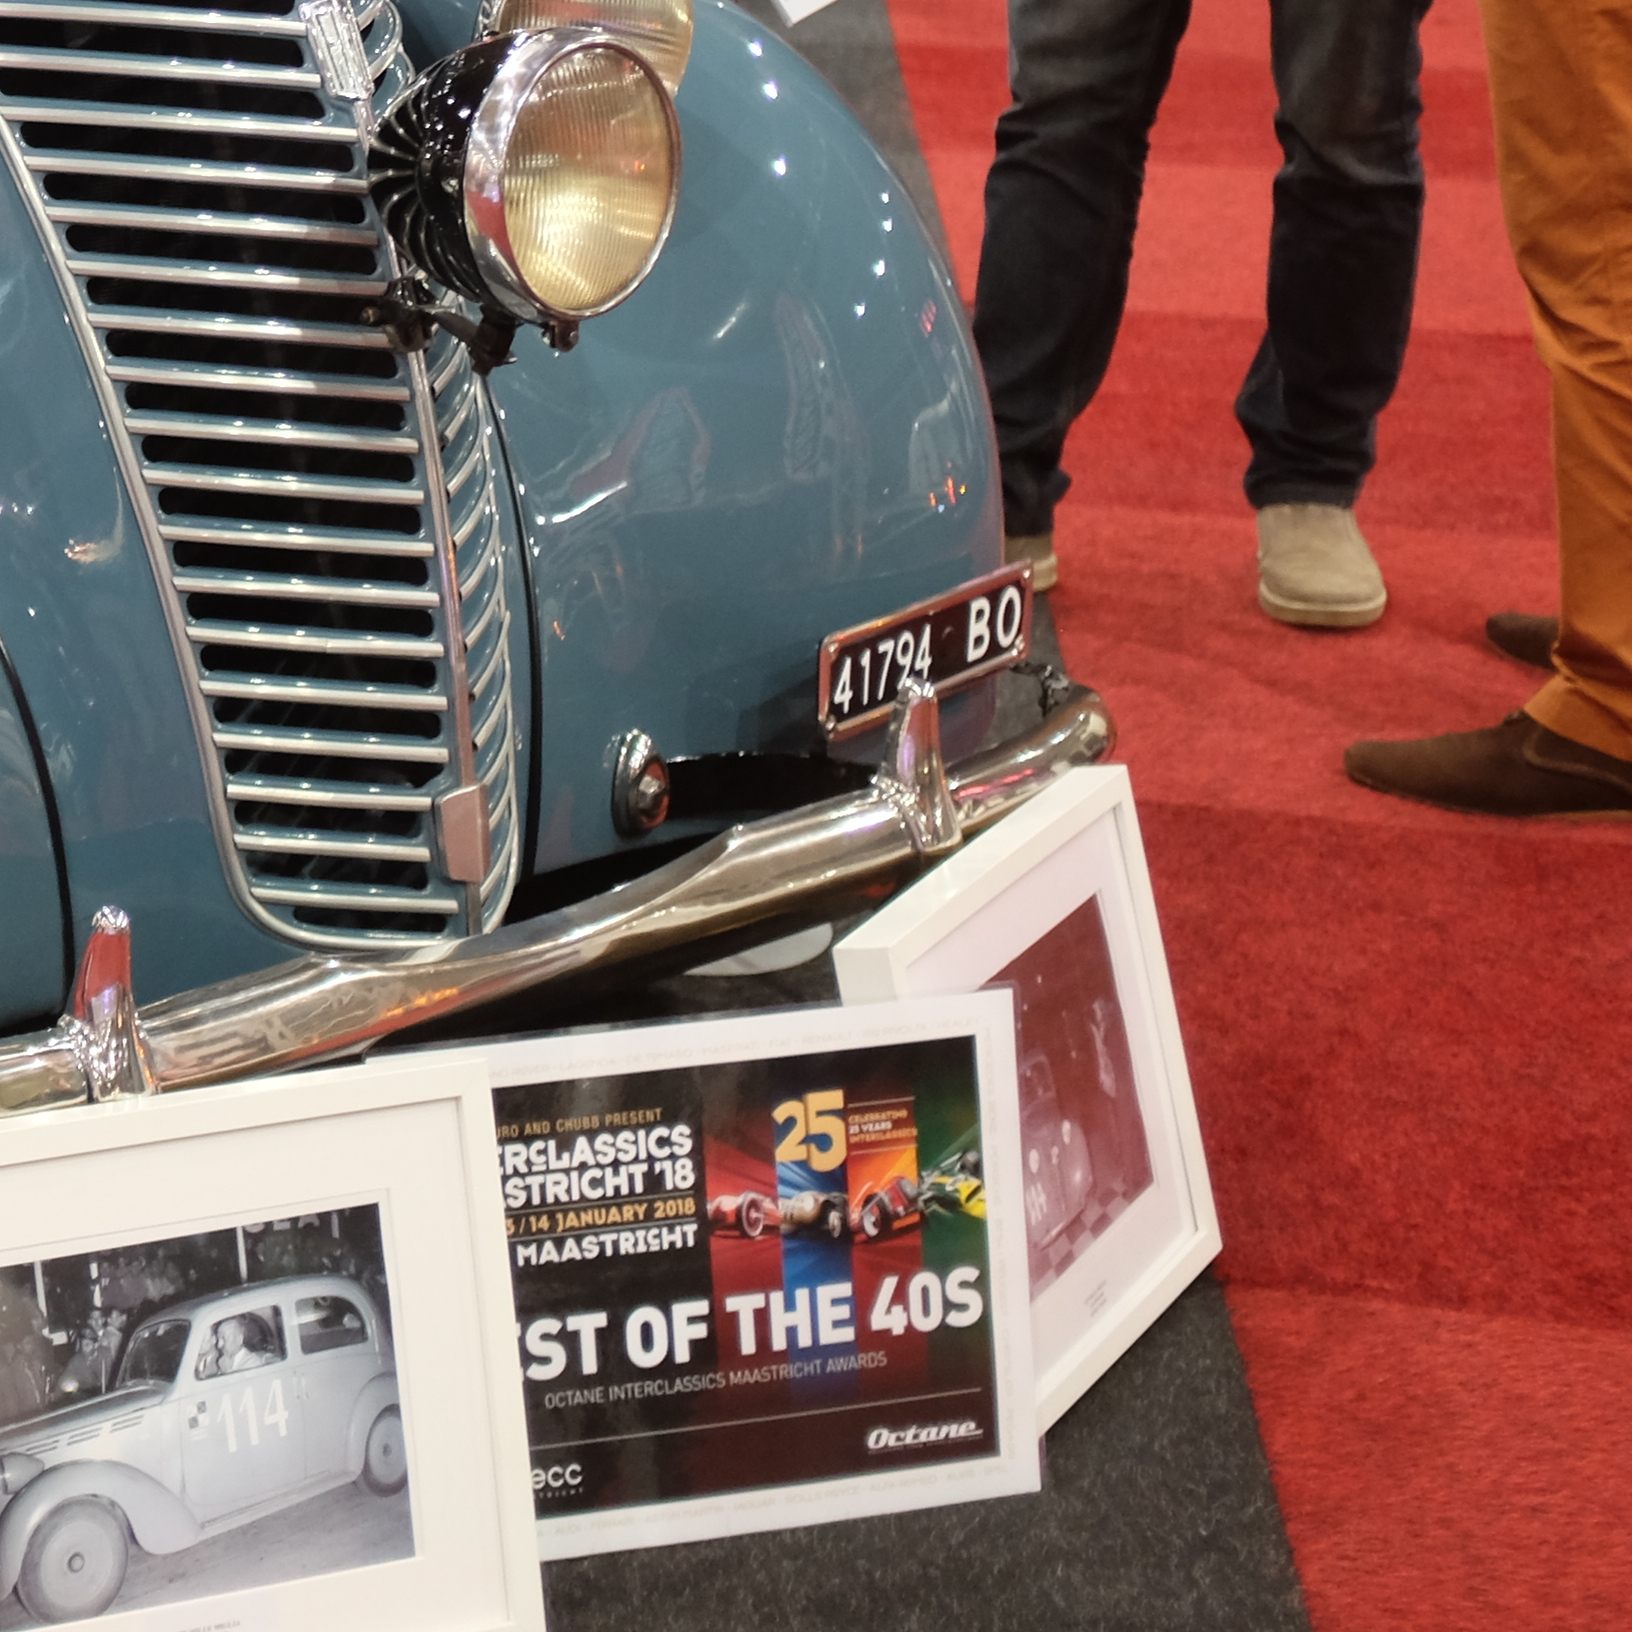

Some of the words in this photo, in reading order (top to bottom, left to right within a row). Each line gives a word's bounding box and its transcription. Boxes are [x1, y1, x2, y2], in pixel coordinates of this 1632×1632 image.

[833, 623, 932, 714] 41794
[967, 585, 1022, 663] BO
[524, 1121, 551, 1136] AND
[556, 1115, 600, 1133] CHUBB
[605, 1108, 663, 1126] PRESENT
[771, 1089, 847, 1172] 25
[498, 1125, 693, 1175] RCLASSICS
[503, 1163, 648, 1209] STRICHT
[530, 1214, 550, 1232] 14
[557, 1203, 648, 1233] JANUARY
[654, 1197, 697, 1218] 2018
[516, 1223, 698, 1267] MAASTRICHT
[516, 1311, 608, 1382] ST
[625, 1299, 711, 1368] OF
[725, 1281, 855, 1356] THE
[870, 1266, 984, 1338] 40S
[544, 1389, 604, 1409] OCTANE
[609, 1373, 726, 1401] INTERCLASSICS
[729, 1361, 822, 1386] MAASTRICHT
[825, 1350, 888, 1373] AWARDS
[216, 1379, 289, 1453] 114
[867, 1421, 984, 1449] Octane
